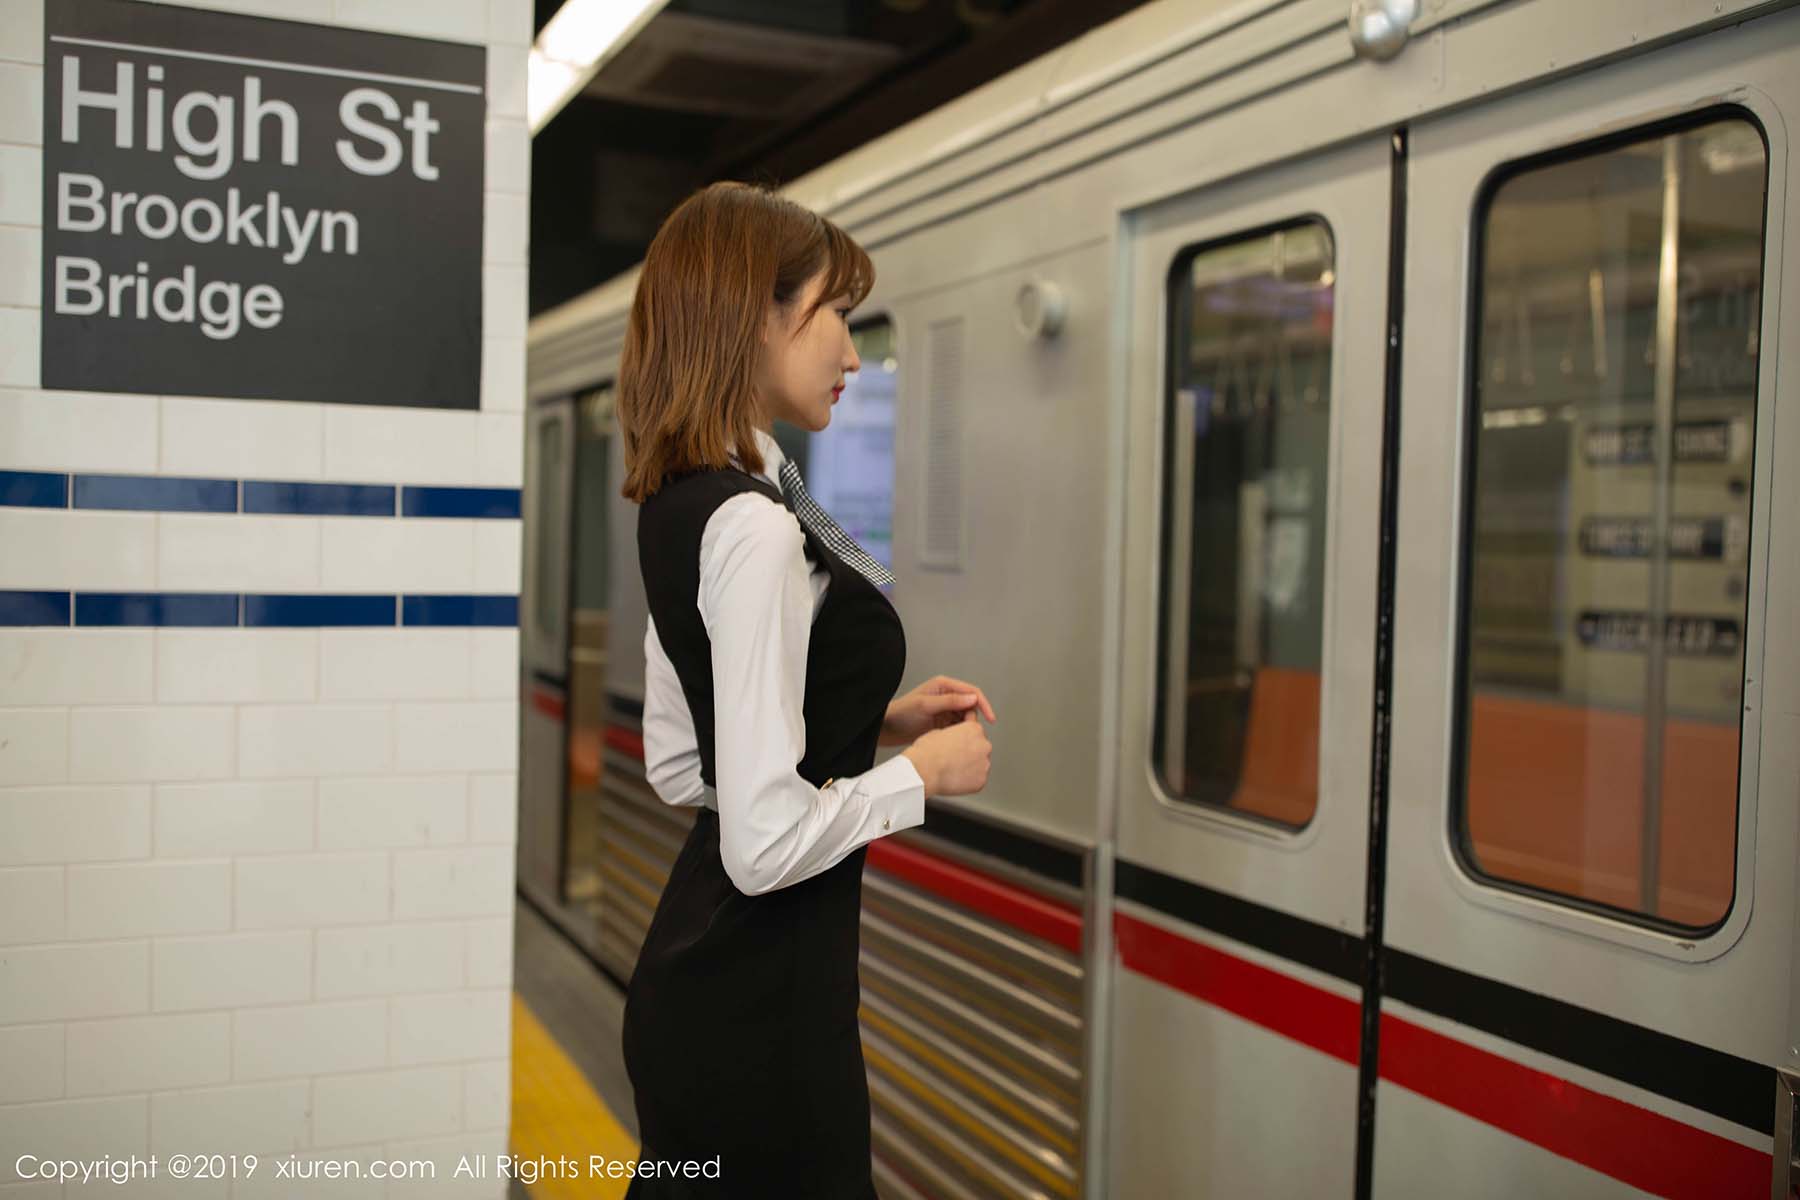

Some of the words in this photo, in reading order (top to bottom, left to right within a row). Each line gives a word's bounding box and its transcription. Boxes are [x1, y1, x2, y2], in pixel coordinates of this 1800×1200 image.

[61, 55, 299, 181] High
[335, 87, 441, 181] St
[57, 172, 359, 265] Brooklyn
[55, 255, 284, 340] Bridge
